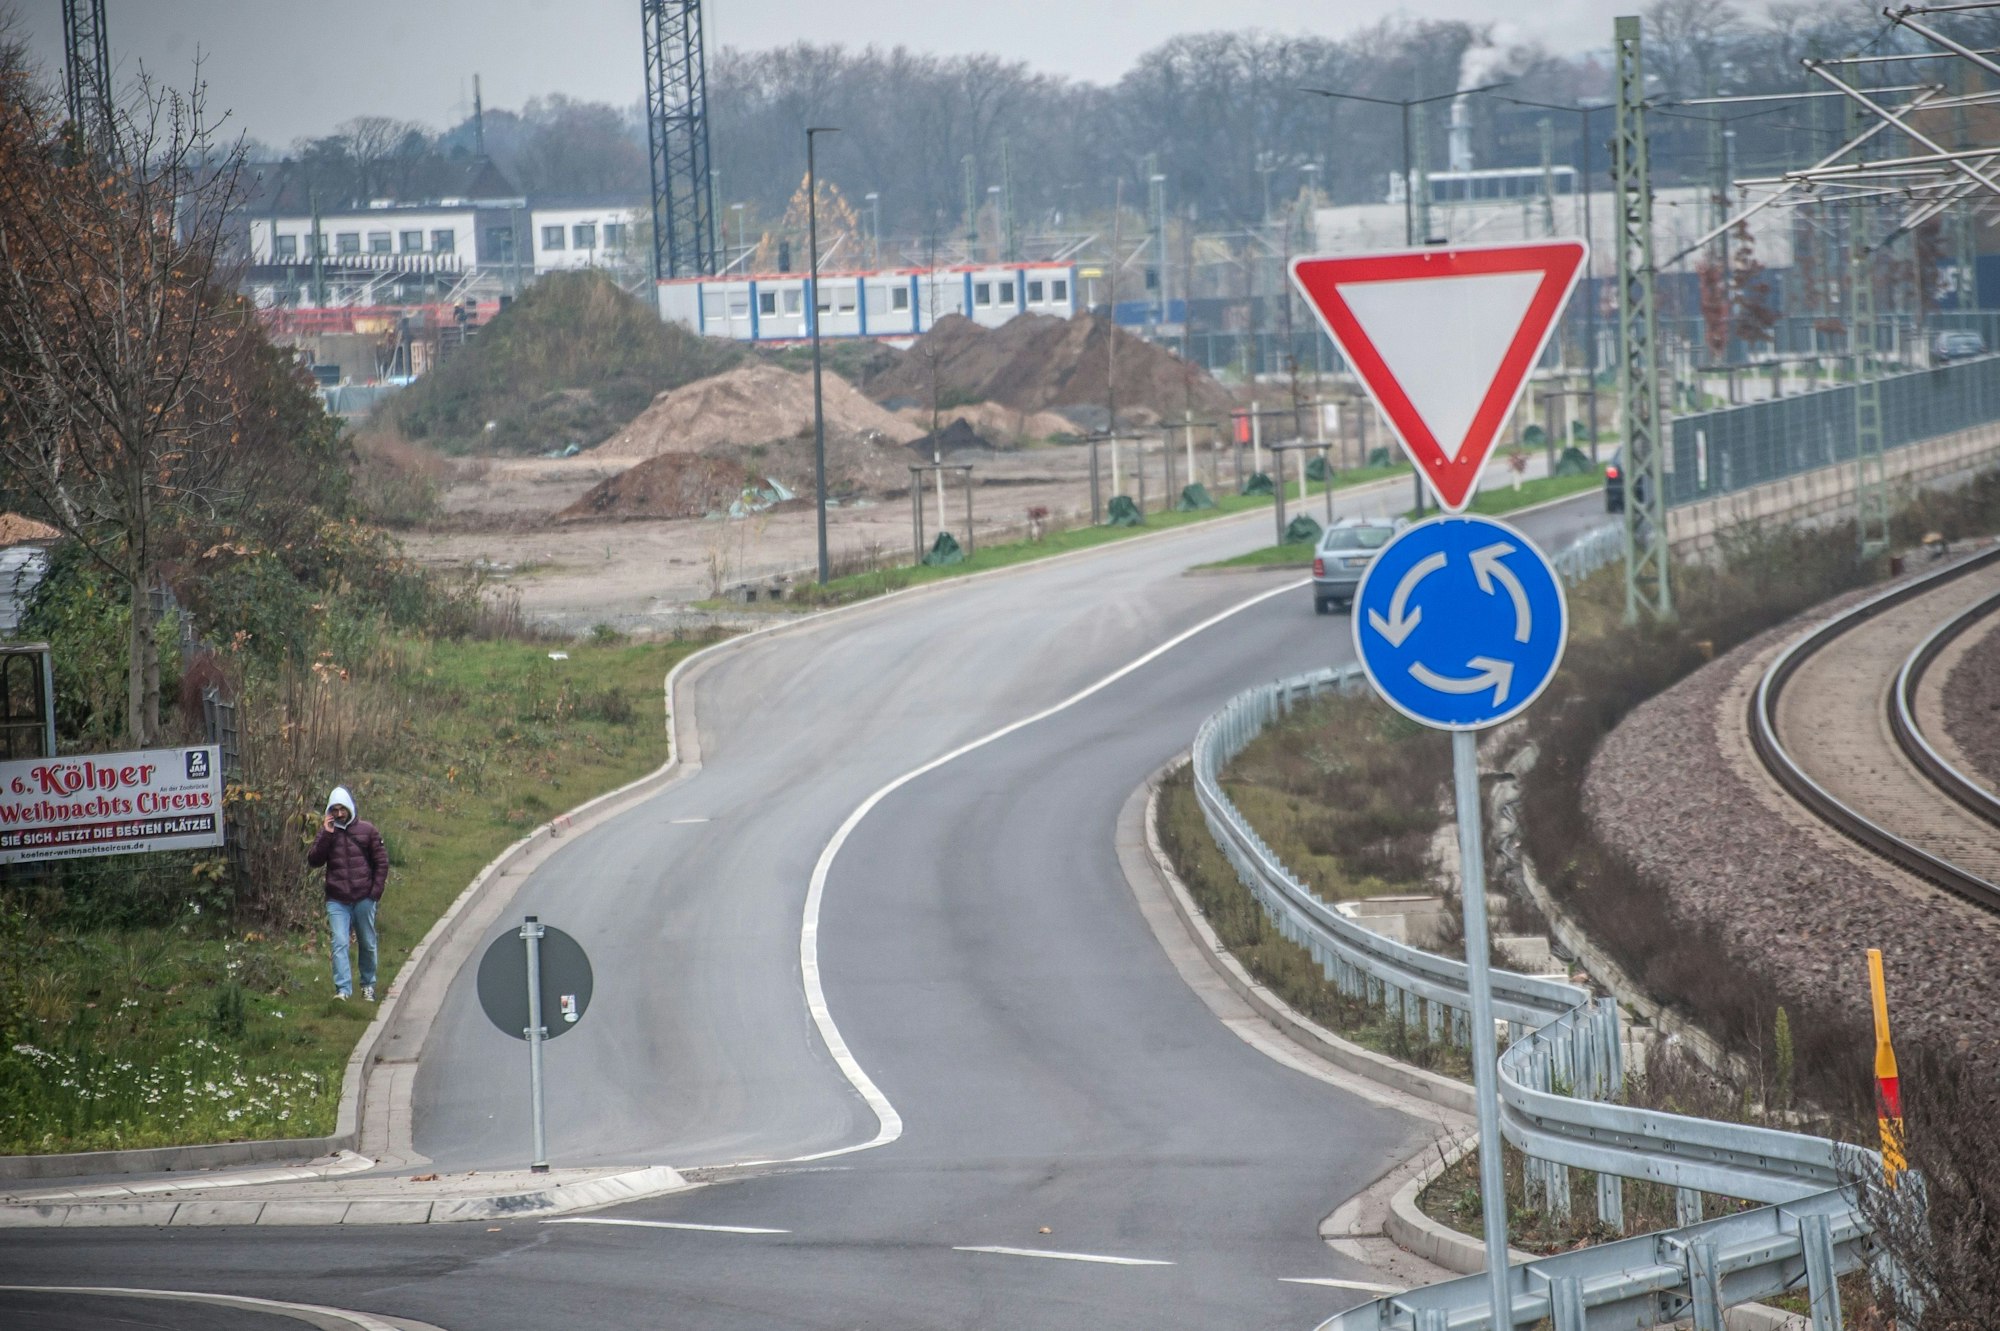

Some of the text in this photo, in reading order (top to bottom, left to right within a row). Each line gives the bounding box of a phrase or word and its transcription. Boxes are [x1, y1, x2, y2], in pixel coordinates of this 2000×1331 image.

[189, 764, 206, 773] JAN
[192, 752, 203, 764] 2
[11, 761, 155, 797] 6. Kölner
[0, 791, 212, 824] Weihnachts Circus
[1, 818, 211, 847] SIE SICH JETZT DIE BESTEN PLÄTZE!
[21, 843, 144, 859] koelner-weihnachtscircus.de
